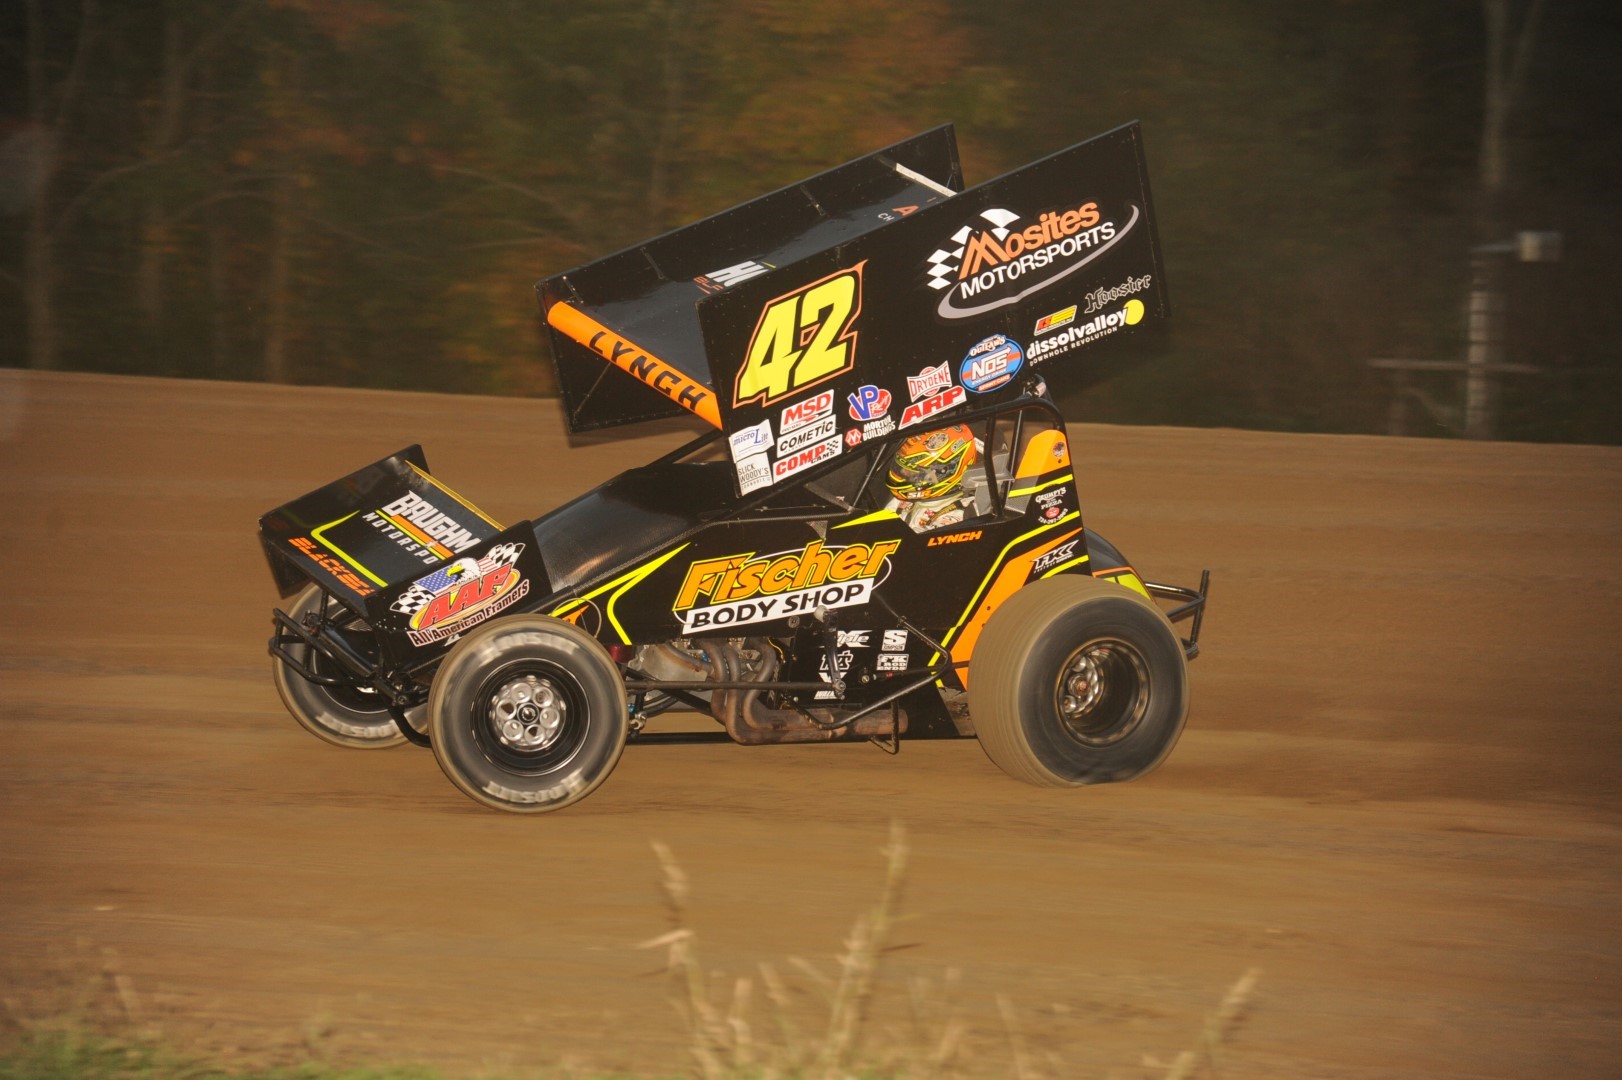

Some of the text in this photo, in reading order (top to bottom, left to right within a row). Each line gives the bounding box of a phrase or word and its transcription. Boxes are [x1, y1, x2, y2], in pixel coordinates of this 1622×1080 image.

[958, 202, 1100, 280] Mosites
[960, 221, 1116, 299] MOTORSPORTS
[1084, 275, 1151, 314] Hoosier
[737, 272, 859, 401] 42
[1026, 308, 1128, 360] dissolvalloy
[1071, 326, 1117, 349] REVOLUTION
[589, 330, 707, 412] LYNCH
[971, 346, 1012, 381] NOS
[909, 370, 950, 395] DRYDENE
[784, 393, 831, 425] MSD
[847, 385, 879, 419] VP
[901, 387, 964, 426] ARP
[780, 421, 834, 452] COMETIC
[863, 415, 892, 432] MORTON
[863, 421, 896, 441] BUILDINGS
[738, 463, 755, 476] SLICK
[776, 444, 826, 476] COMP
[810, 450, 835, 464] CAMS
[1041, 499, 1063, 510] PIZZA
[927, 531, 982, 547] LYNCH
[673, 539, 901, 612] Fischer
[410, 579, 529, 647] All American Framers
[691, 583, 865, 629] BODY SHOP
